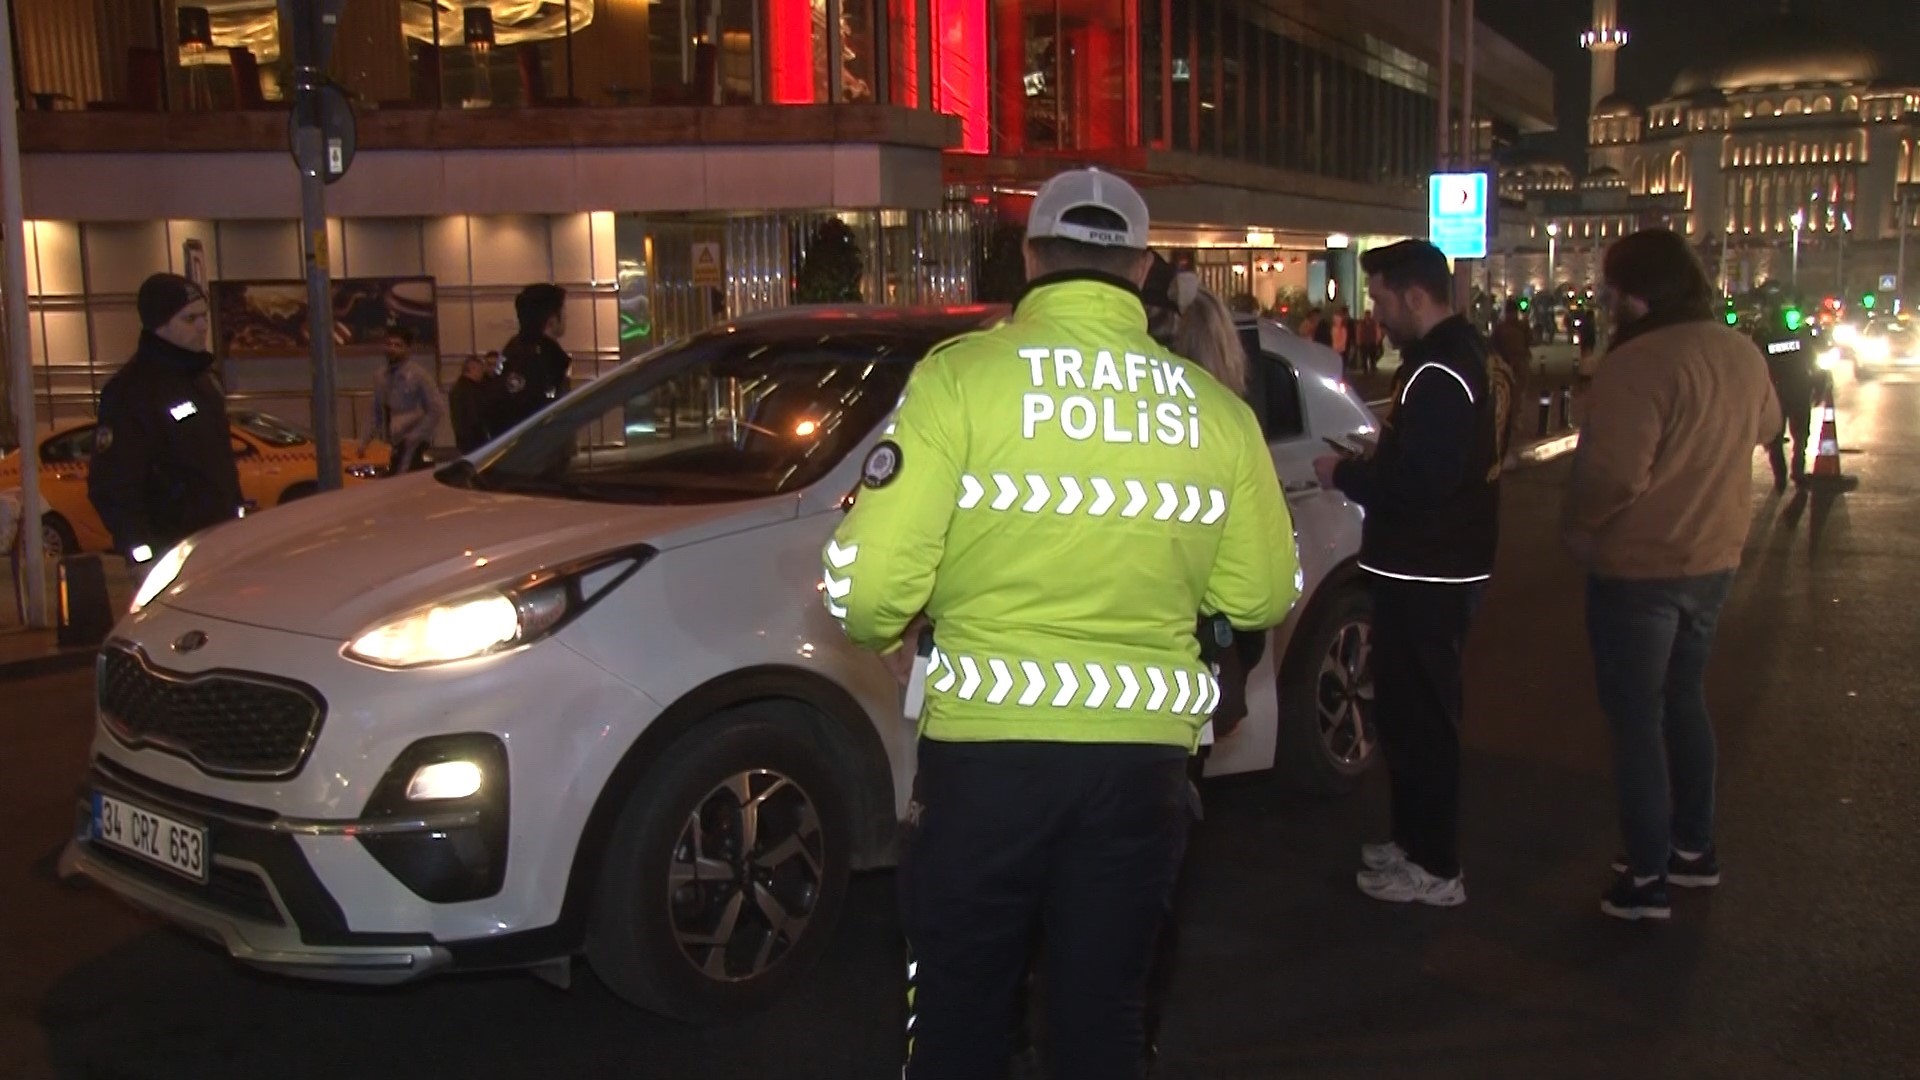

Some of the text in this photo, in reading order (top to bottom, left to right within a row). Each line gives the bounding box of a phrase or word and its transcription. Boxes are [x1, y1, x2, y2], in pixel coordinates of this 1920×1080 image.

[103, 801, 200, 871] 34 CRZ 653
